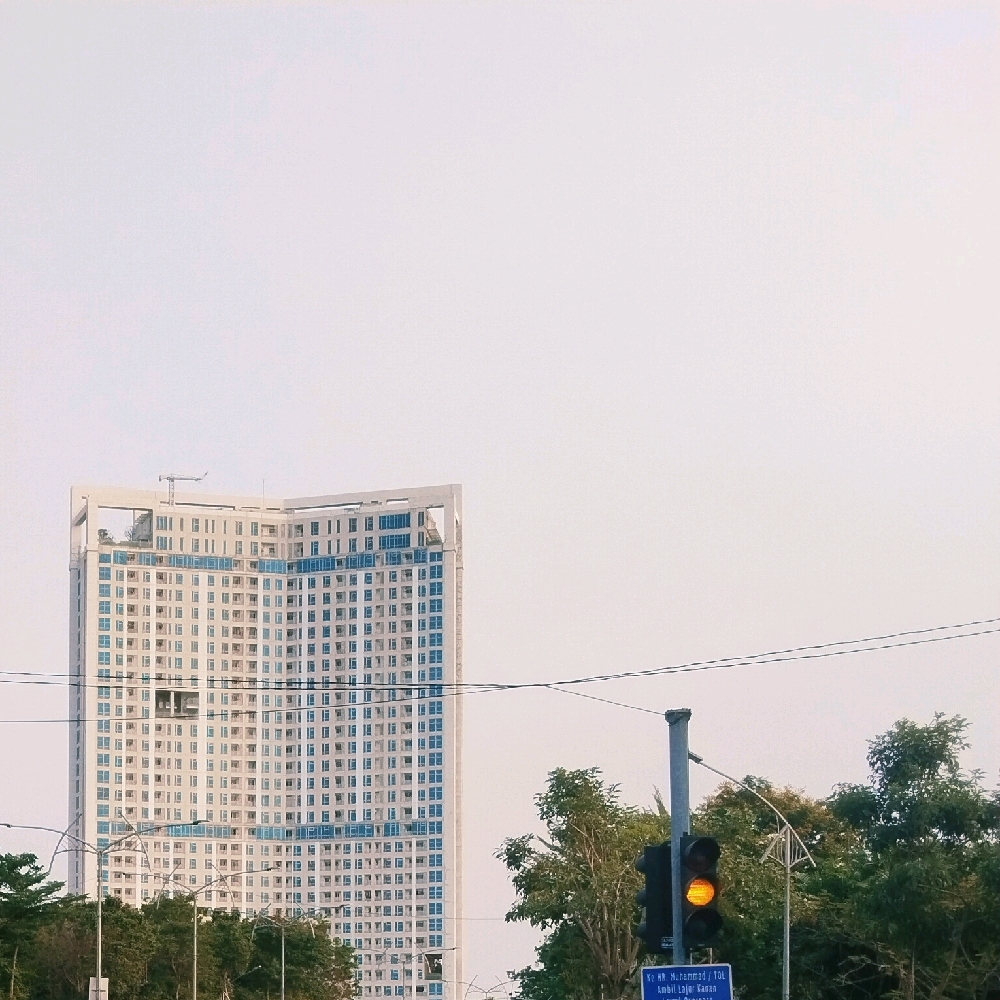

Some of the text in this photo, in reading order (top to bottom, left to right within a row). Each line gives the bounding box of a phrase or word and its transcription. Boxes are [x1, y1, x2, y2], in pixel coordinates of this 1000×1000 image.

[670, 970, 706, 981] Muhammad
[713, 970, 726, 980] TOL
[657, 983, 717, 996] Ambil Lajur Kanan
